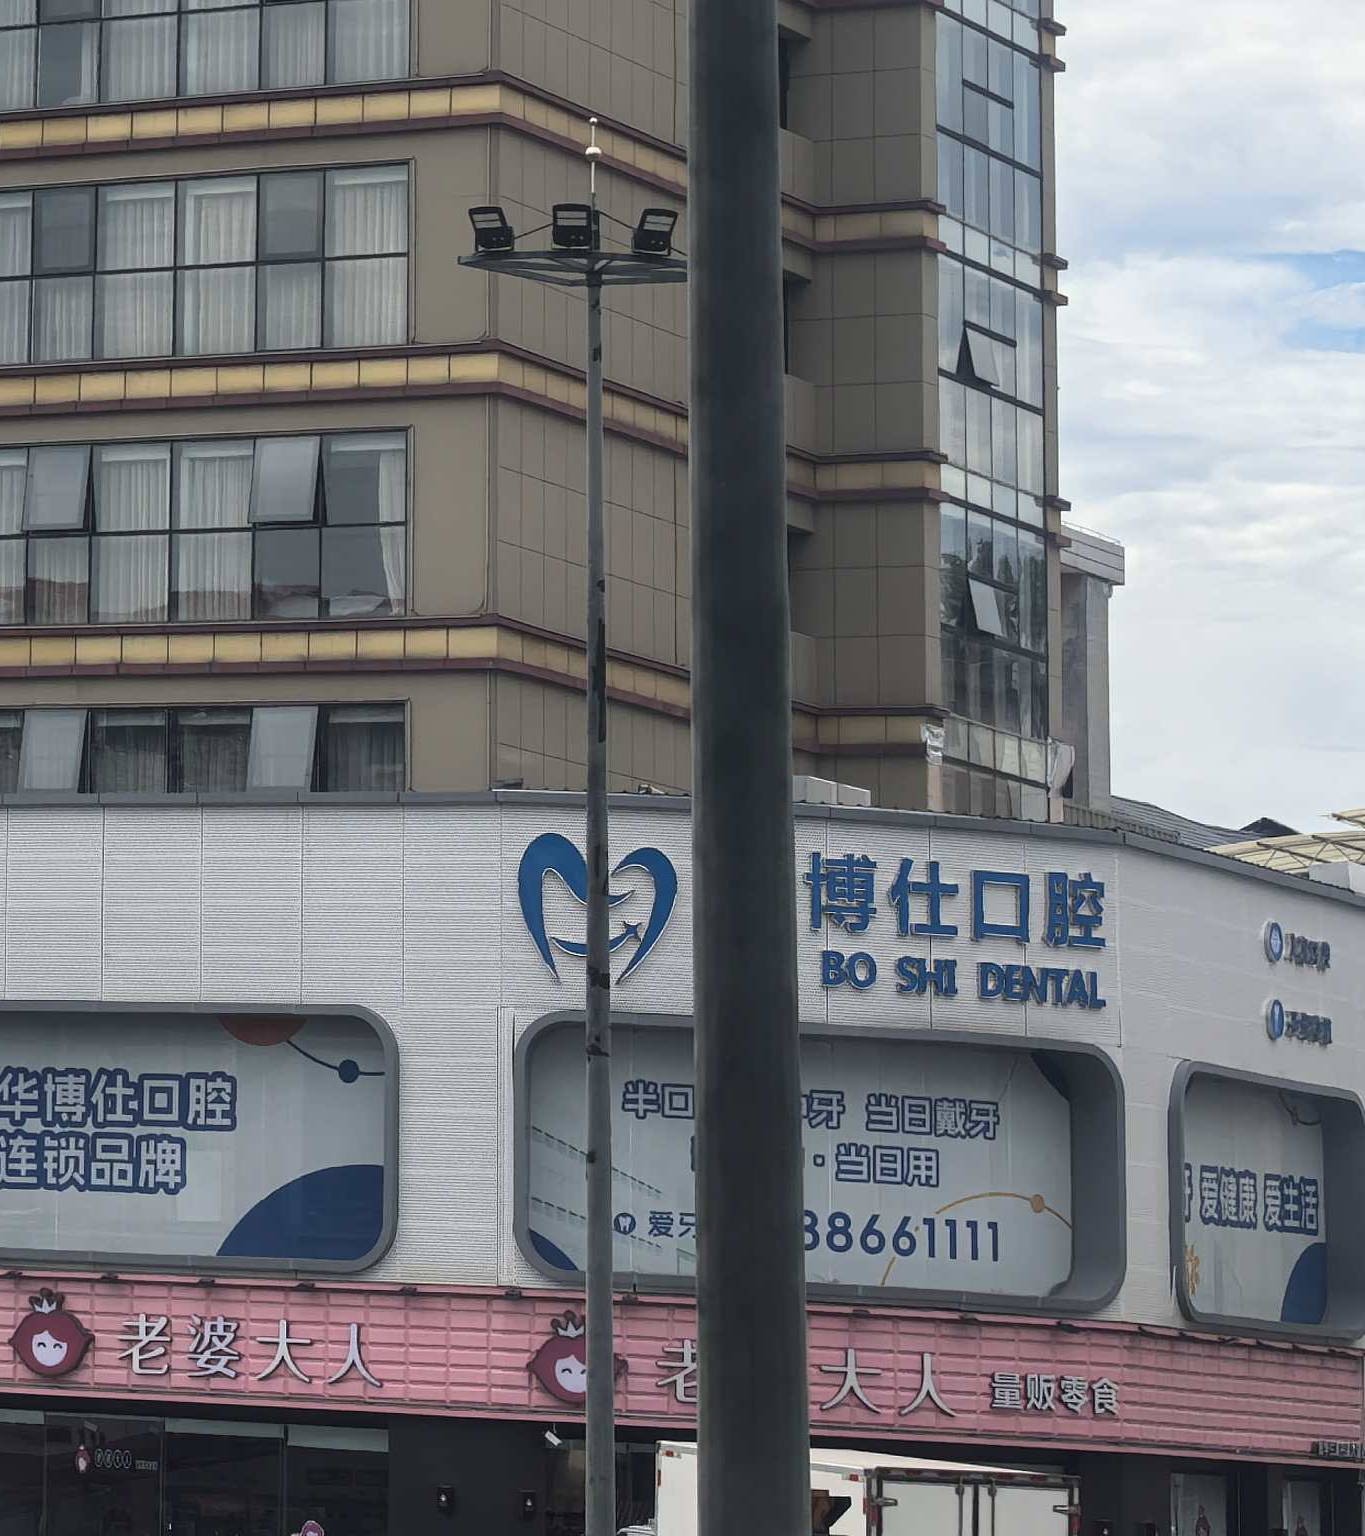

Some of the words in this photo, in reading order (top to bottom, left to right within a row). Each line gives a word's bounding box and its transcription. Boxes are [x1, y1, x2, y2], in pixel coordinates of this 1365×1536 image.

[821, 950, 877, 990] BO
[896, 955, 958, 997] SHI
[977, 962, 1107, 1010] DENTAL
[865, 1093, 1000, 1140] 当日戴牙
[1200, 1165, 1257, 1229] 爱健康
[1264, 1173, 1319, 1236] 爱生活
[118, 1312, 384, 1389] 老婆大人
[655, 1338, 958, 1418] 老大人
[990, 1371, 1120, 1416] 量贩零食
